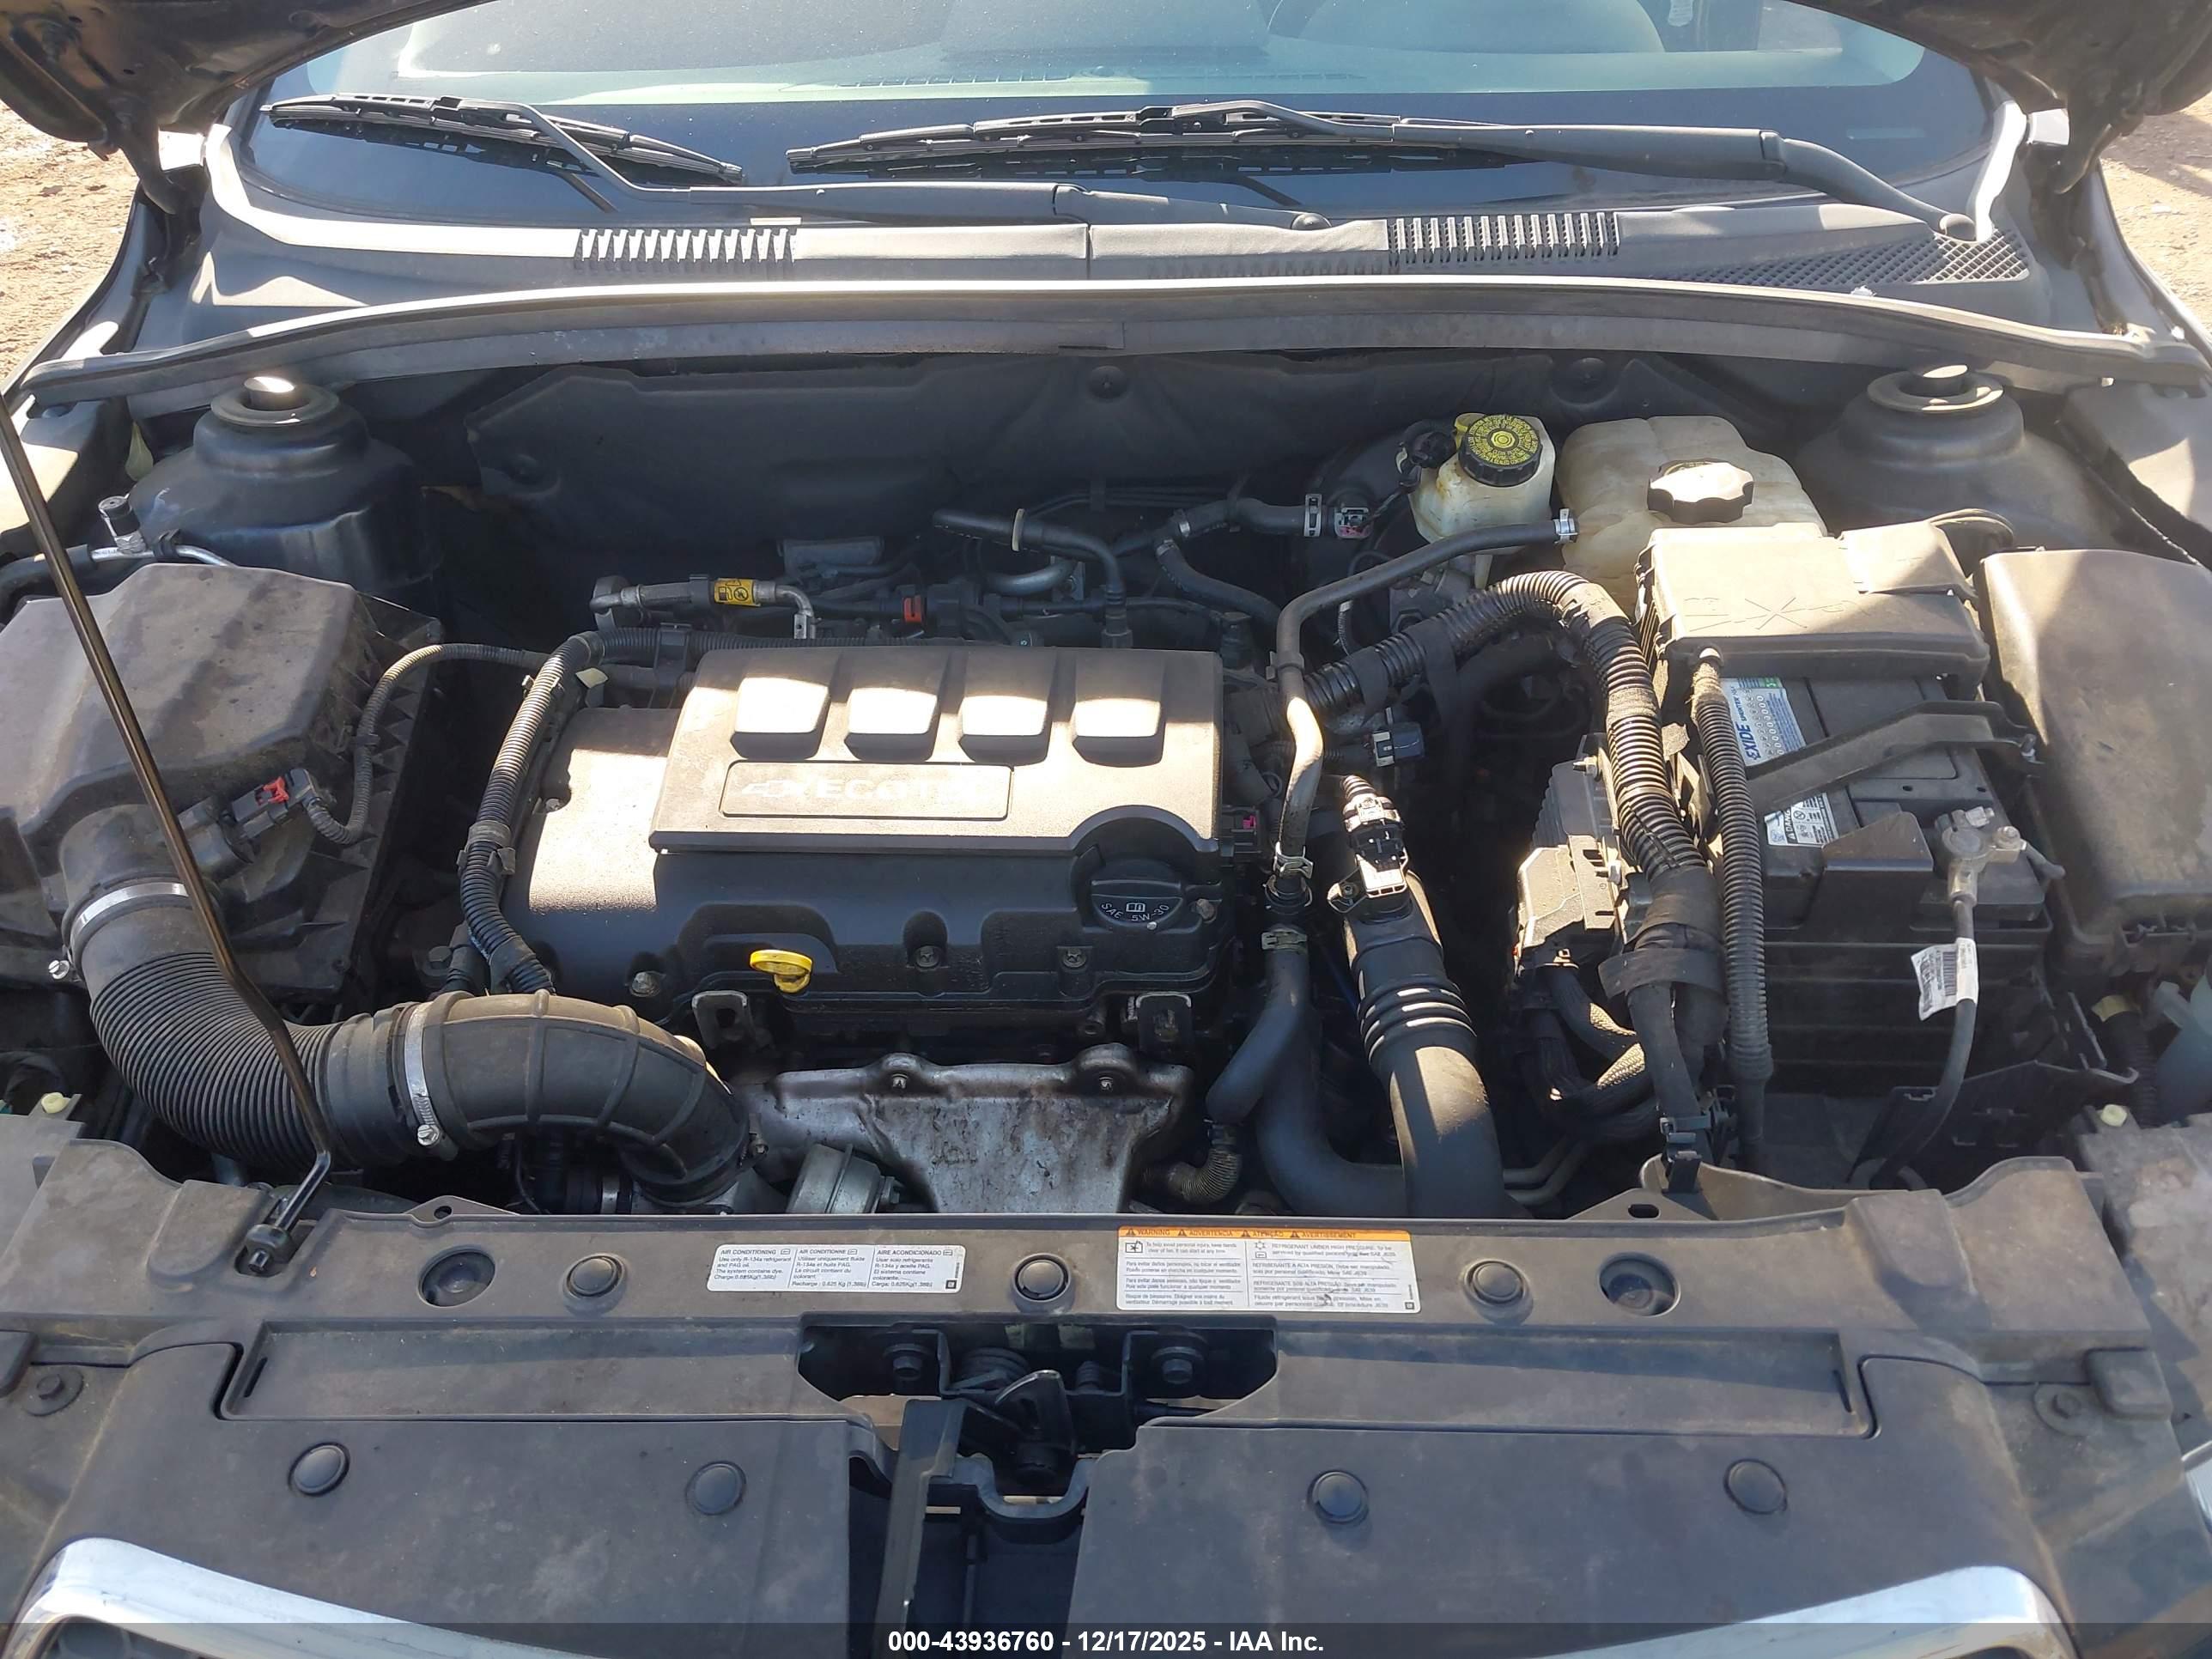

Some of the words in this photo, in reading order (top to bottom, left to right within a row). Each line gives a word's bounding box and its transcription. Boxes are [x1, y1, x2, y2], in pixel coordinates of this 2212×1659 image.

[1735, 720, 1761, 760] EXIDE
[1785, 808, 1794, 831] DANG
[1101, 902, 1124, 919] SAE
[1131, 904, 1170, 921] 5W-30
